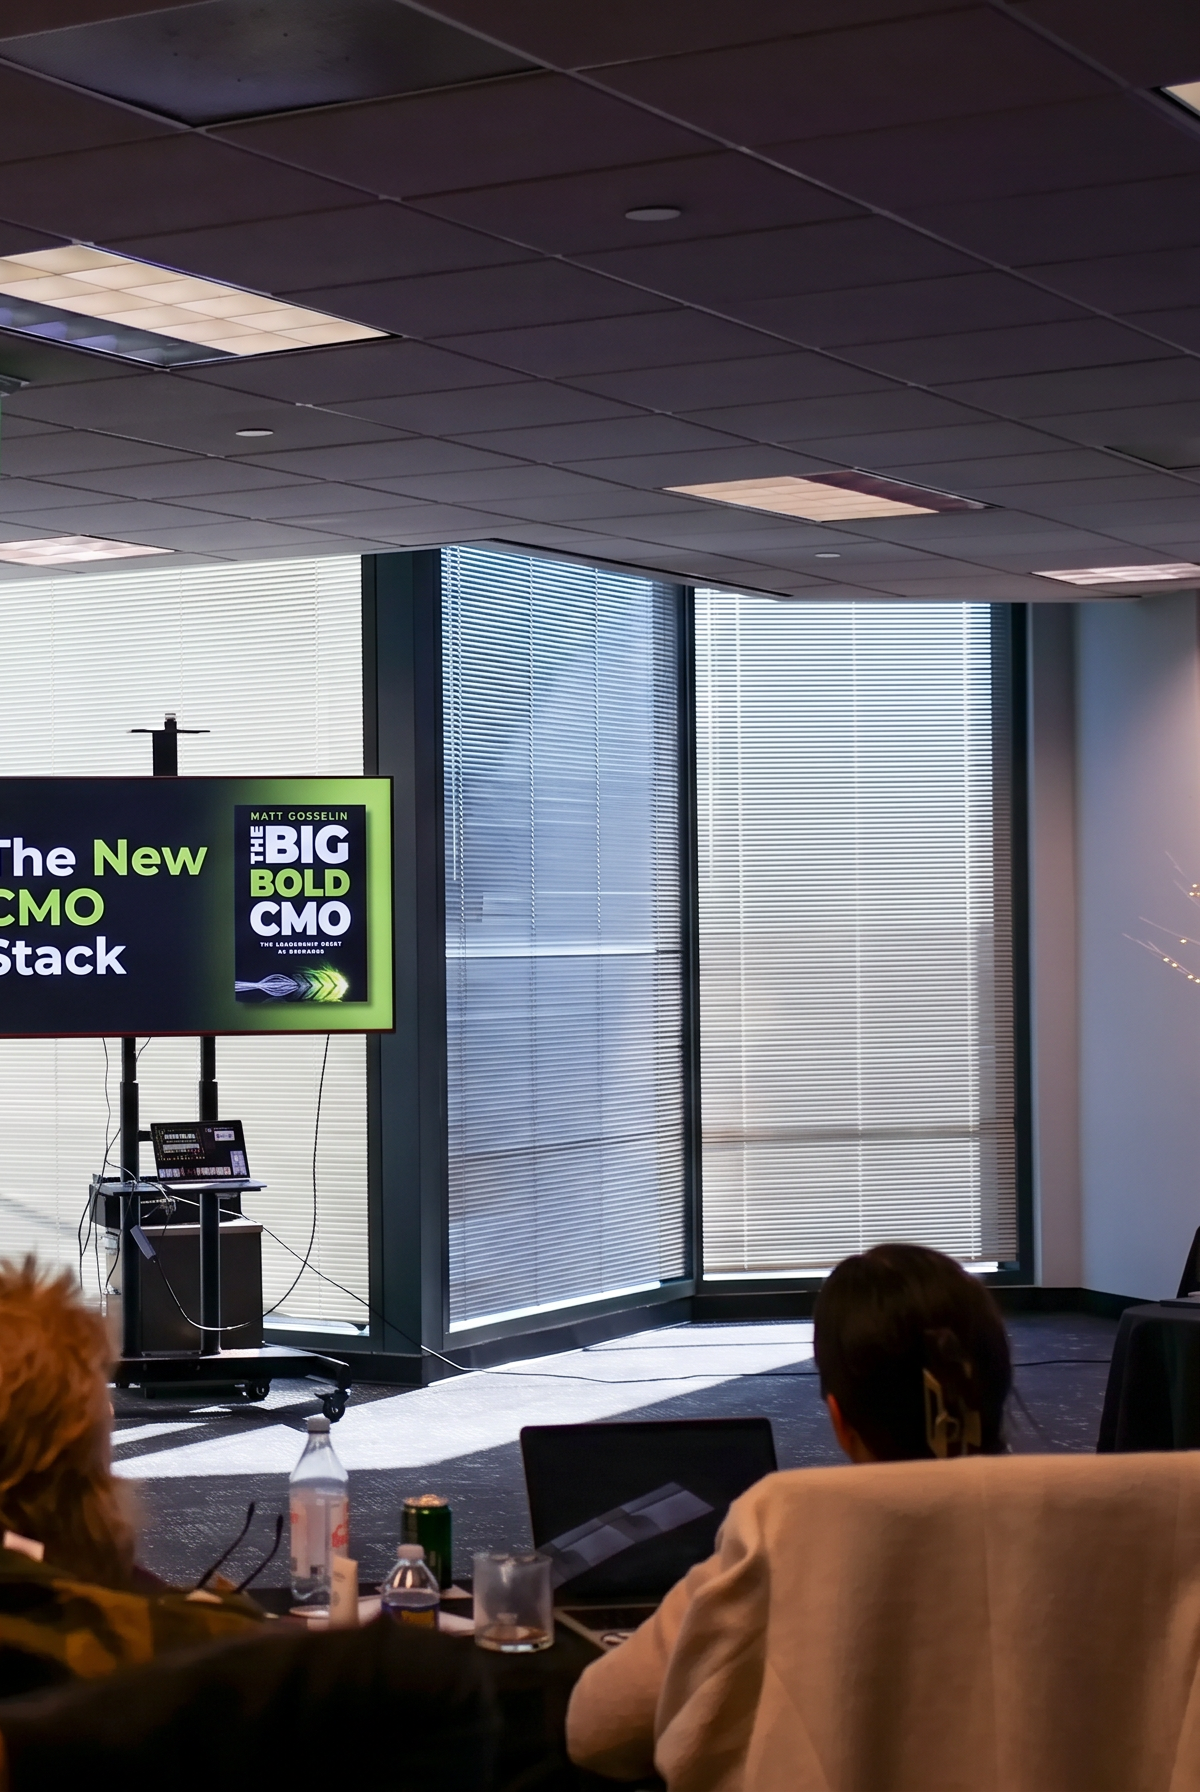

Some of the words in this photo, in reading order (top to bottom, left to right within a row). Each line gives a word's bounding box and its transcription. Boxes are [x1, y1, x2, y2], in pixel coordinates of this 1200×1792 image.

[250, 811, 283, 821] MATT
[288, 811, 348, 821] GOSSELIN
[93, 838, 208, 877] New
[250, 825, 264, 865] THE
[265, 824, 349, 865] BIG
[250, 868, 351, 898] BOLD
[249, 900, 351, 937] CMO
